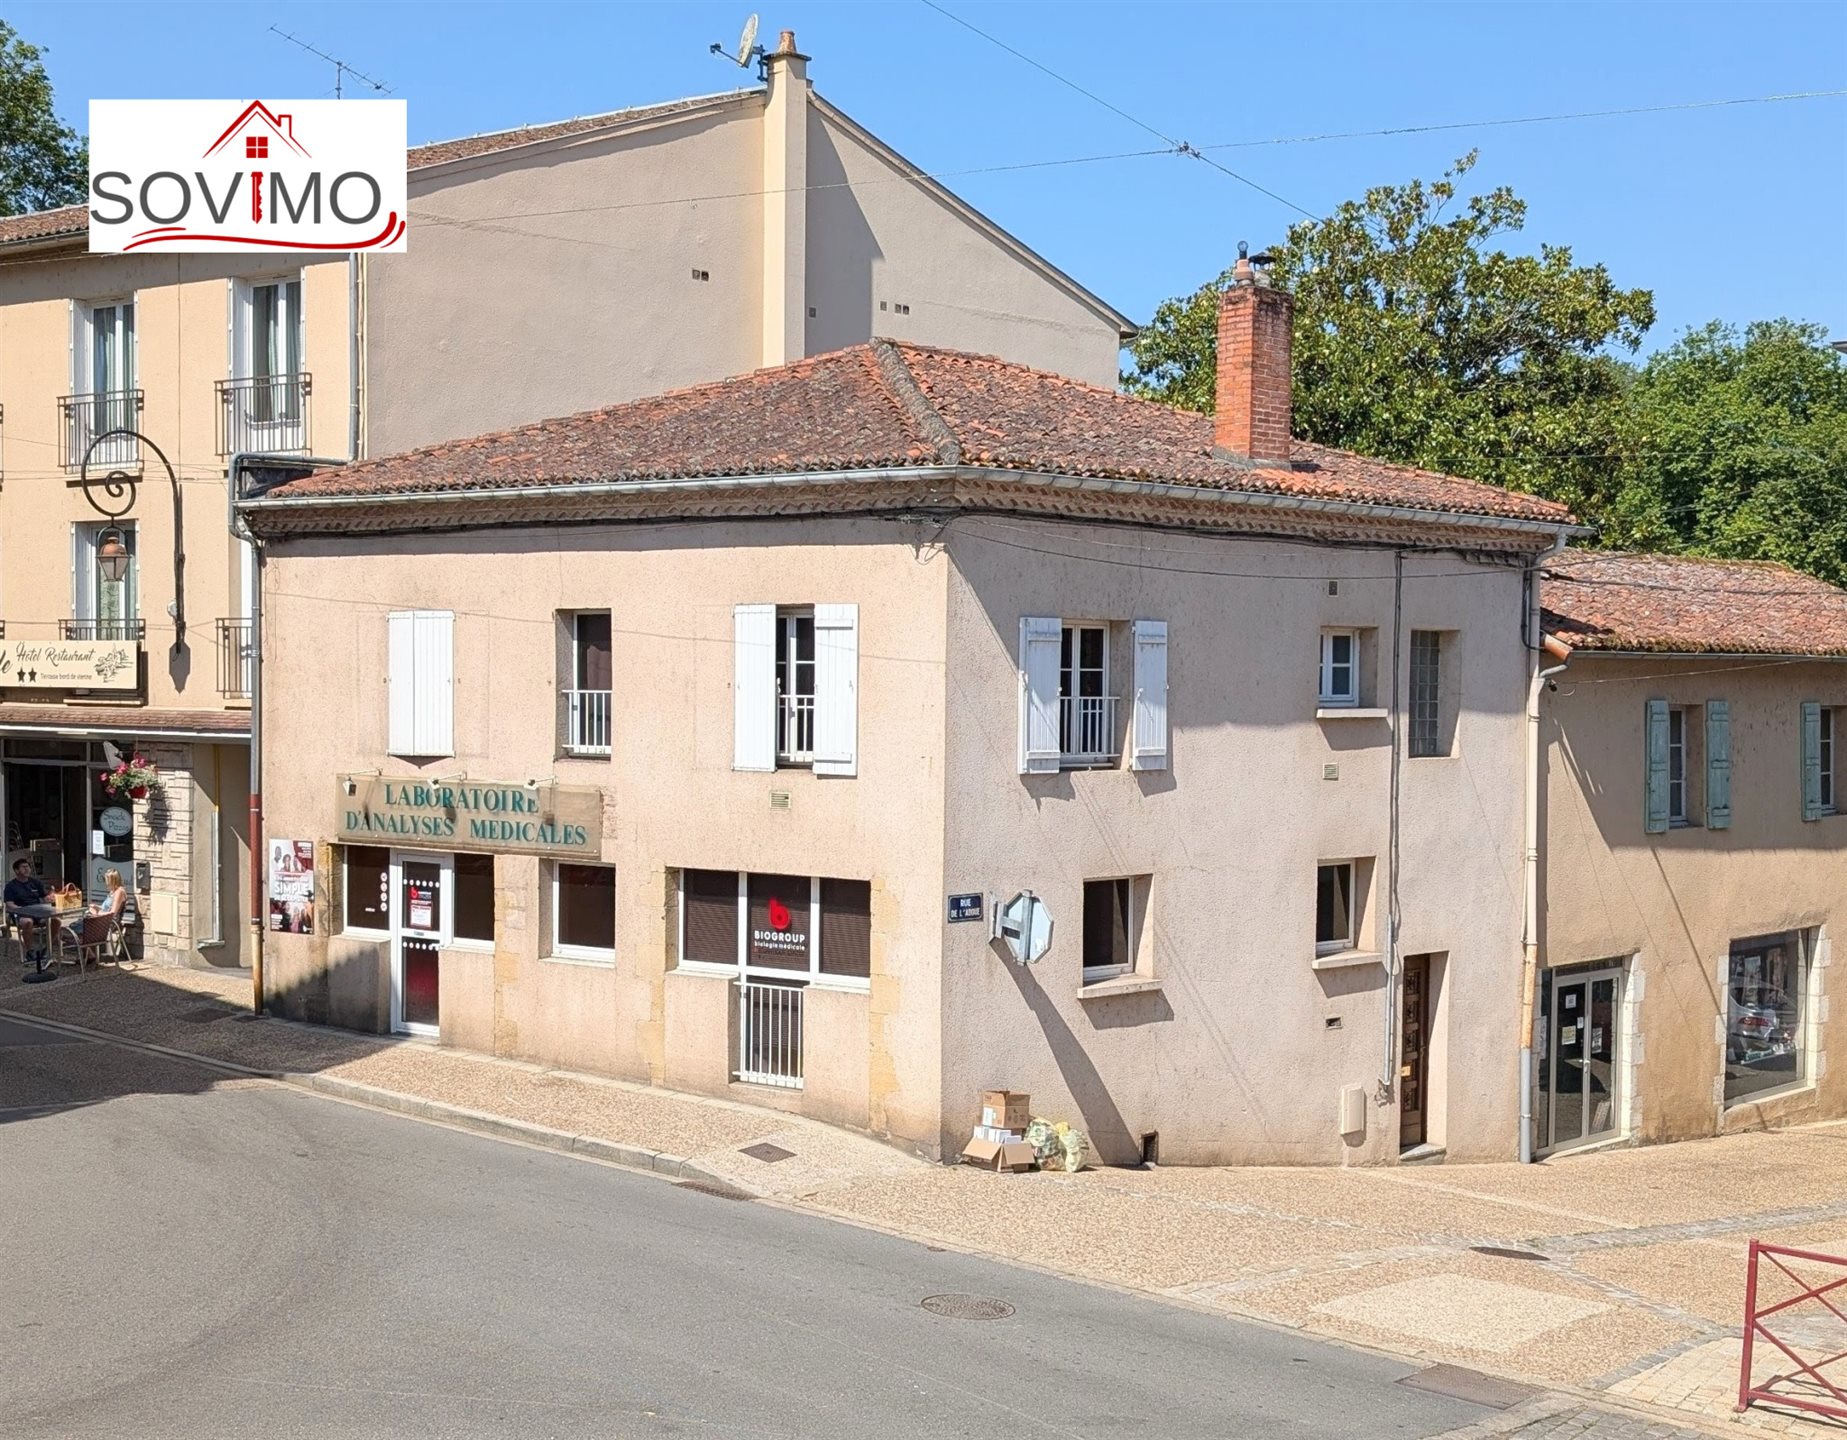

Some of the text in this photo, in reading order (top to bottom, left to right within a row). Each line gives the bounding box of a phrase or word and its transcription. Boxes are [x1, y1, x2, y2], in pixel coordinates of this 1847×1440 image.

[45, 647, 96, 667] Restaurant
[385, 783, 540, 814] LABORATOIRE
[345, 810, 587, 846] D'ANALYSES MEDICALES
[960, 898, 971, 907] RUE
[950, 909, 958, 918] DE
[754, 930, 805, 943] BIOGROUP
[754, 940, 778, 949] biologie
